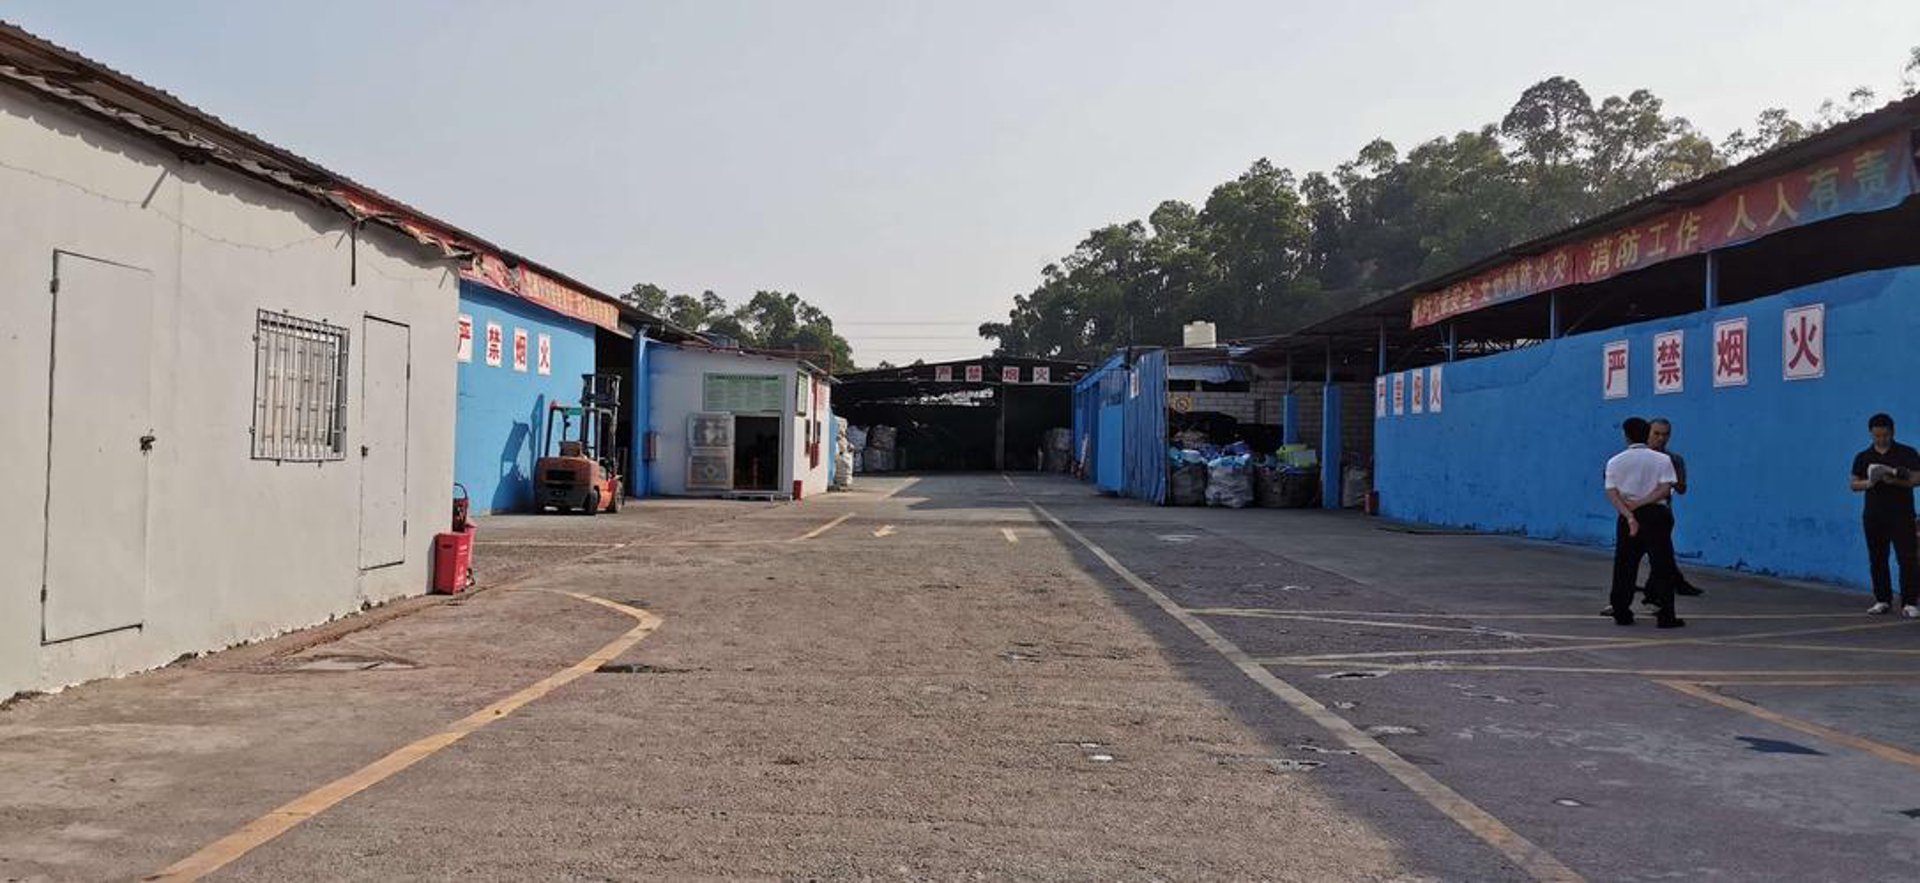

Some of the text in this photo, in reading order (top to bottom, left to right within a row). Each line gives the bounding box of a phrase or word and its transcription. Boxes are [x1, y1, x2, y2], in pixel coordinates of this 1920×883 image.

[1588, 151, 1890, 276] 消防工作 人人有责
[458, 320, 549, 368] 严禁烟火
[1606, 316, 1819, 389] 严禁烟火
